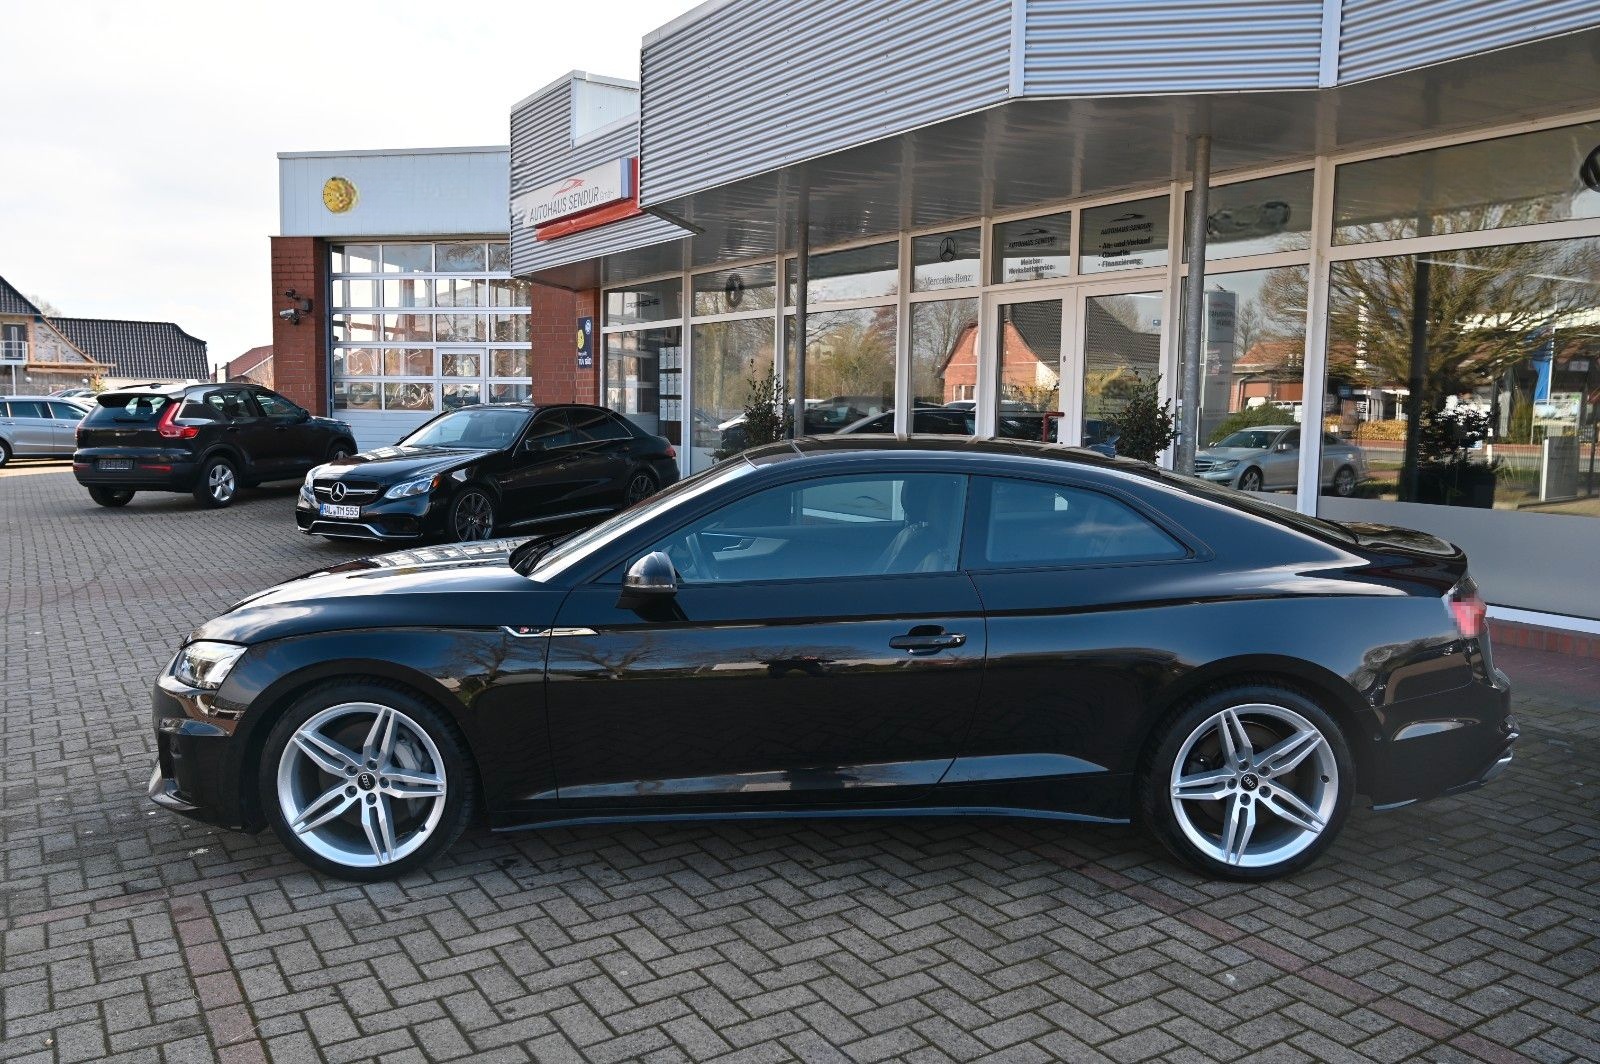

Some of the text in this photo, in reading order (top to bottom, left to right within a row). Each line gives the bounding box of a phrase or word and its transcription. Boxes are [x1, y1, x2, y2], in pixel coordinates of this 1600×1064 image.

[529, 197, 567, 222] AUTOHAUS
[568, 186, 599, 211] SENDUR
[924, 273, 974, 287] Mercedes-Benz
[625, 298, 660, 309] PORSCHE
[346, 506, 359, 517] 555
